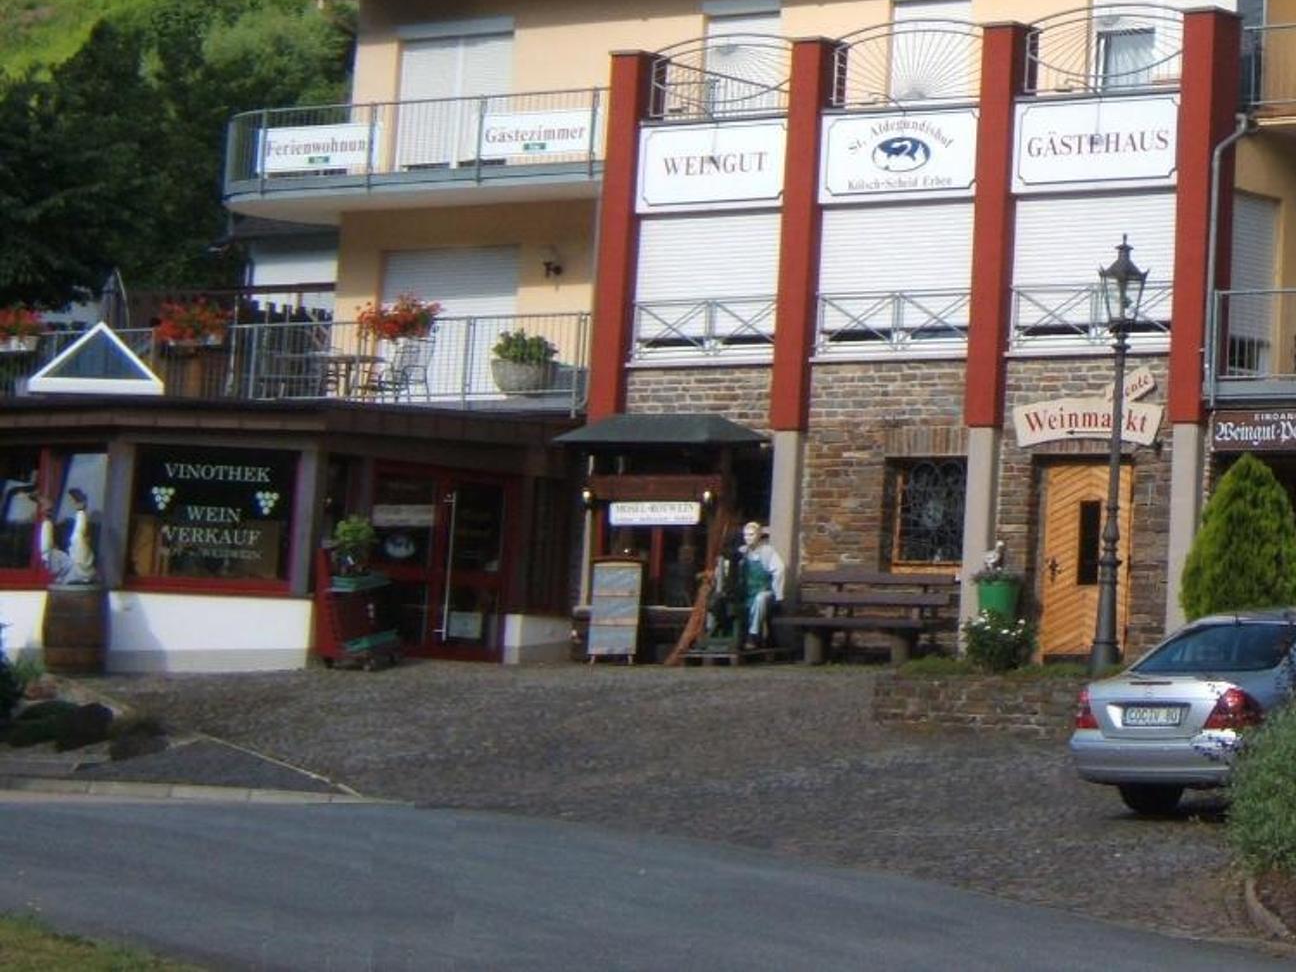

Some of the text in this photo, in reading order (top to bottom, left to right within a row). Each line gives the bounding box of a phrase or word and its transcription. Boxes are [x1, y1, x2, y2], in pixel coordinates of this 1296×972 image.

[485, 125, 586, 145] Gästezimmer
[1027, 129, 1169, 158] GÄSTEHAUS
[265, 136, 369, 157] Ferienwohnun
[663, 151, 768, 177] WEINGUT
[1024, 407, 1148, 433] Weinmakt
[164, 462, 271, 483] VINOTHEK
[186, 504, 242, 523] WEIN
[164, 526, 261, 546] VERKAUF
